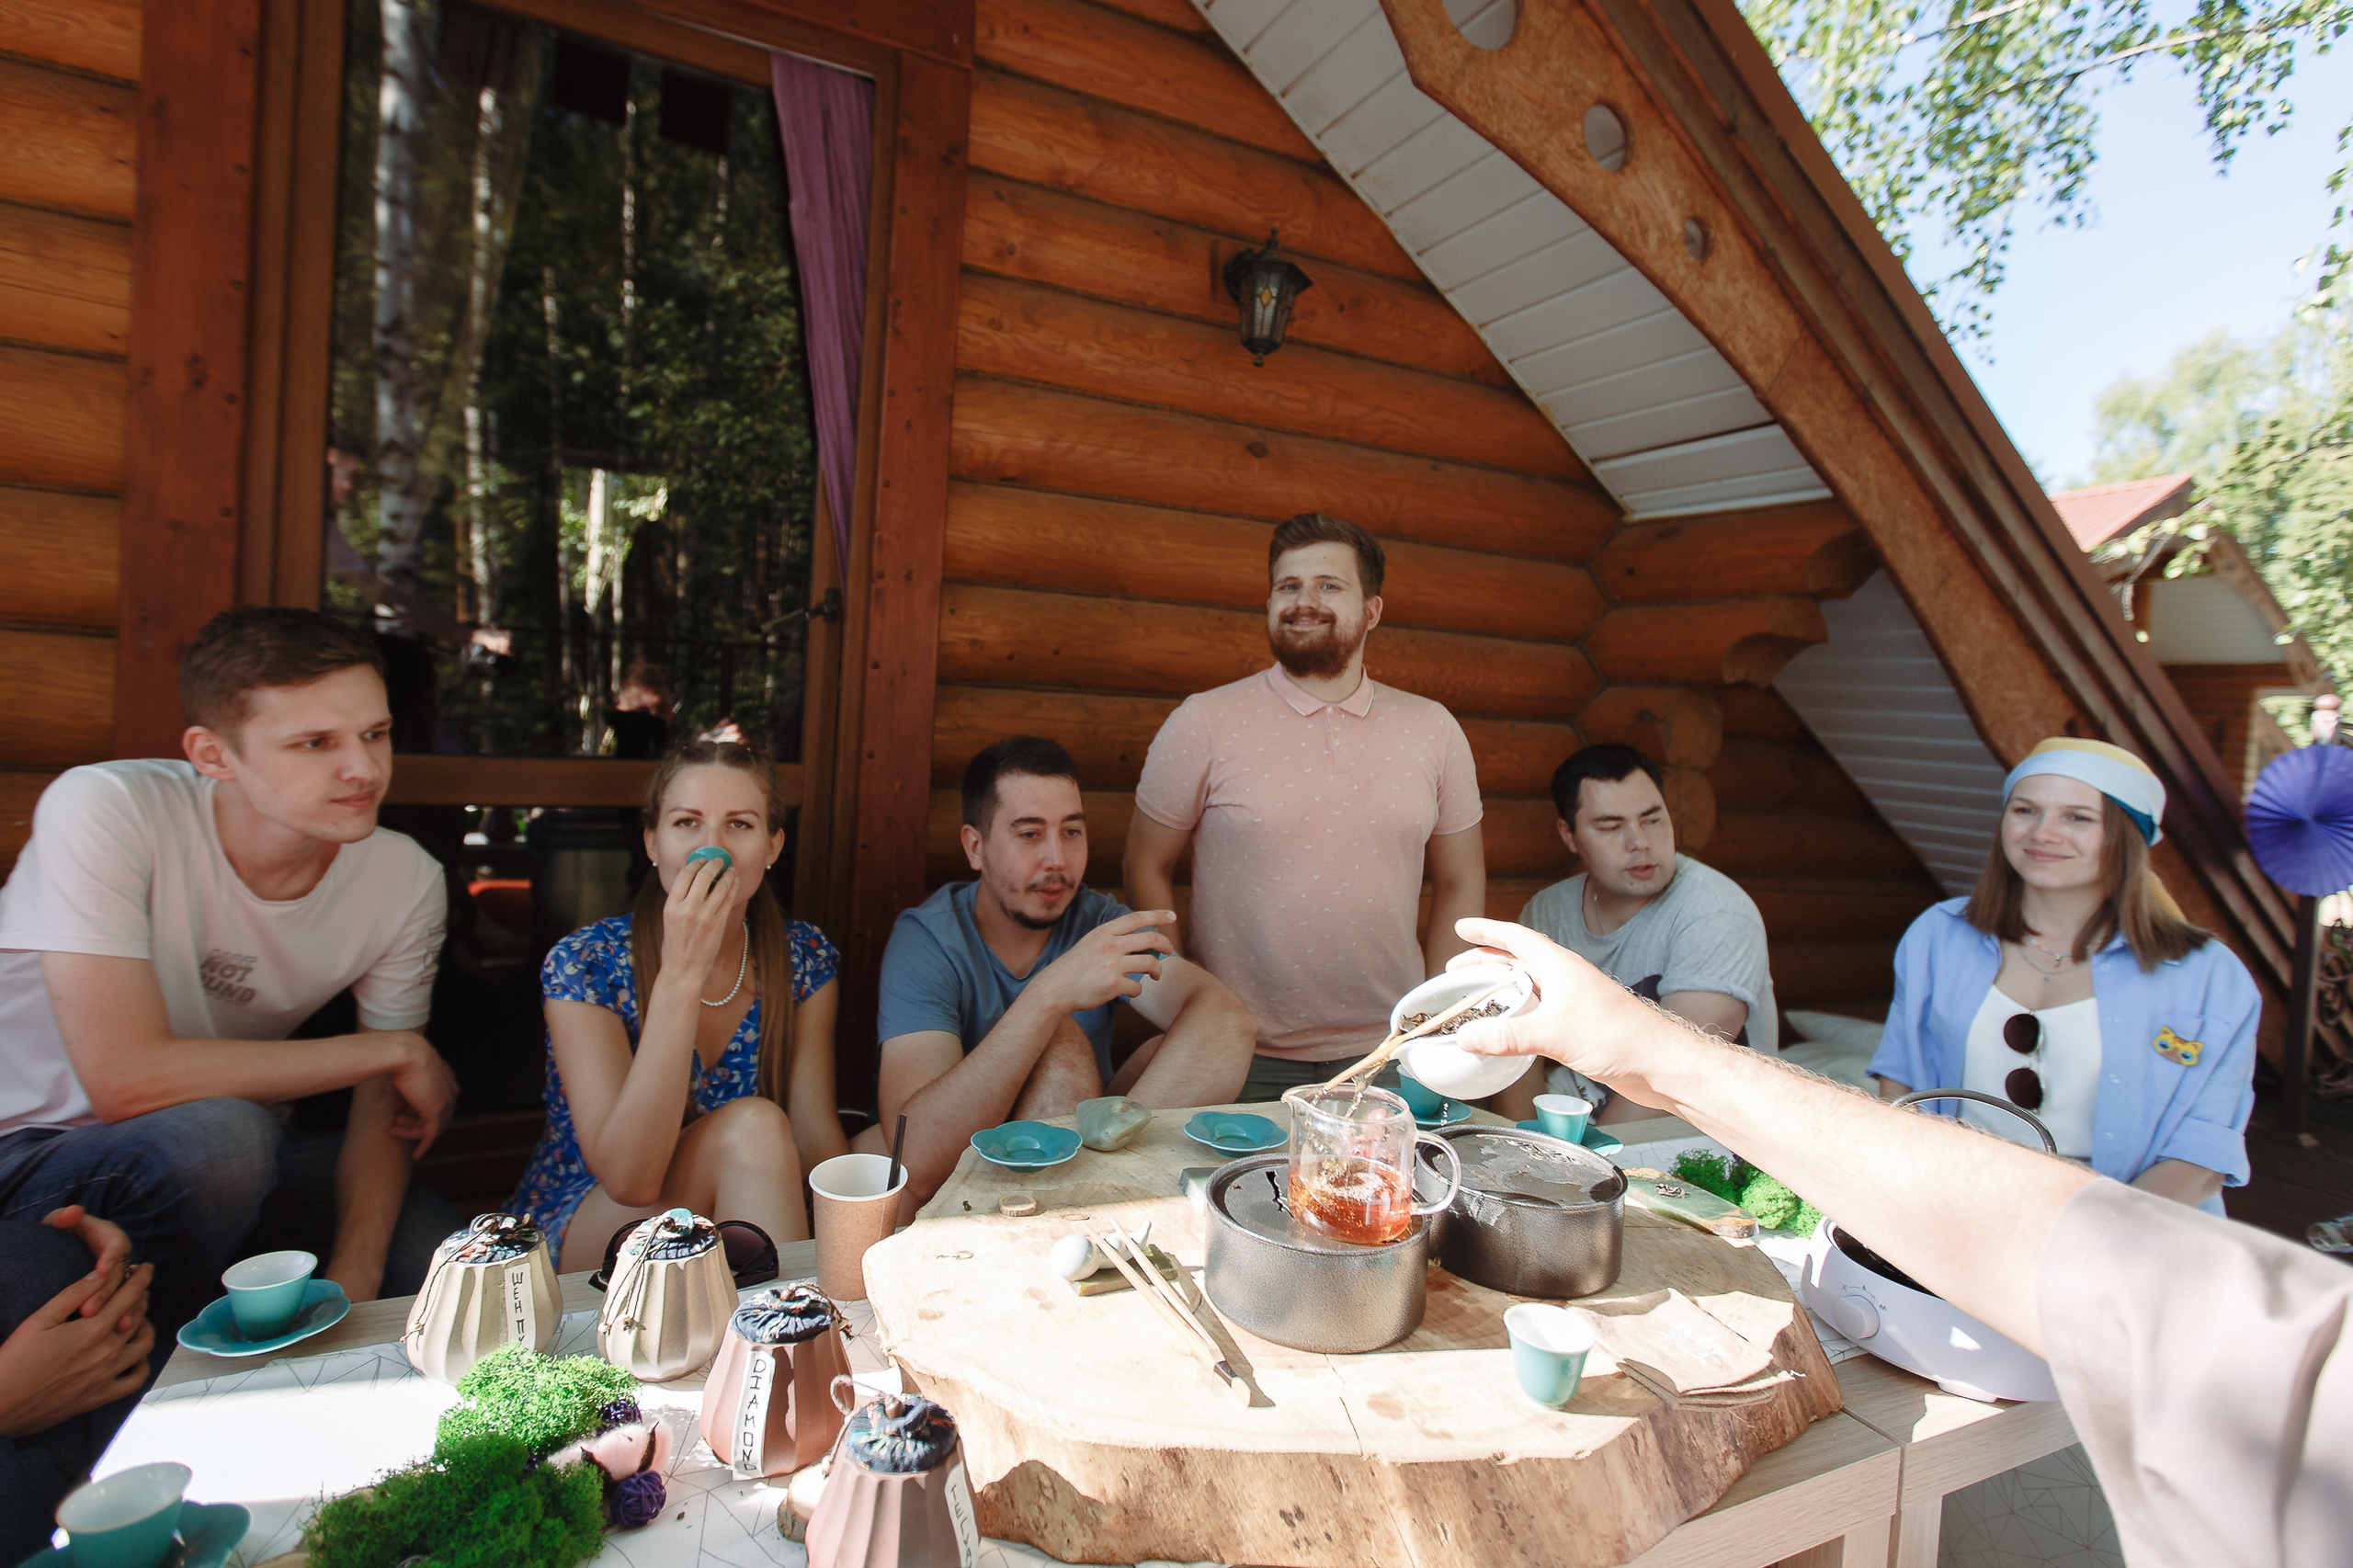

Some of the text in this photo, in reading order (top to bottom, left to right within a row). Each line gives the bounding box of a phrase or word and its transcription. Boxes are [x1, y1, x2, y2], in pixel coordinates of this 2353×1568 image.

[511, 1271, 526, 1345] ШЕН ПУ
[742, 1358, 767, 1471] DIAMOND
